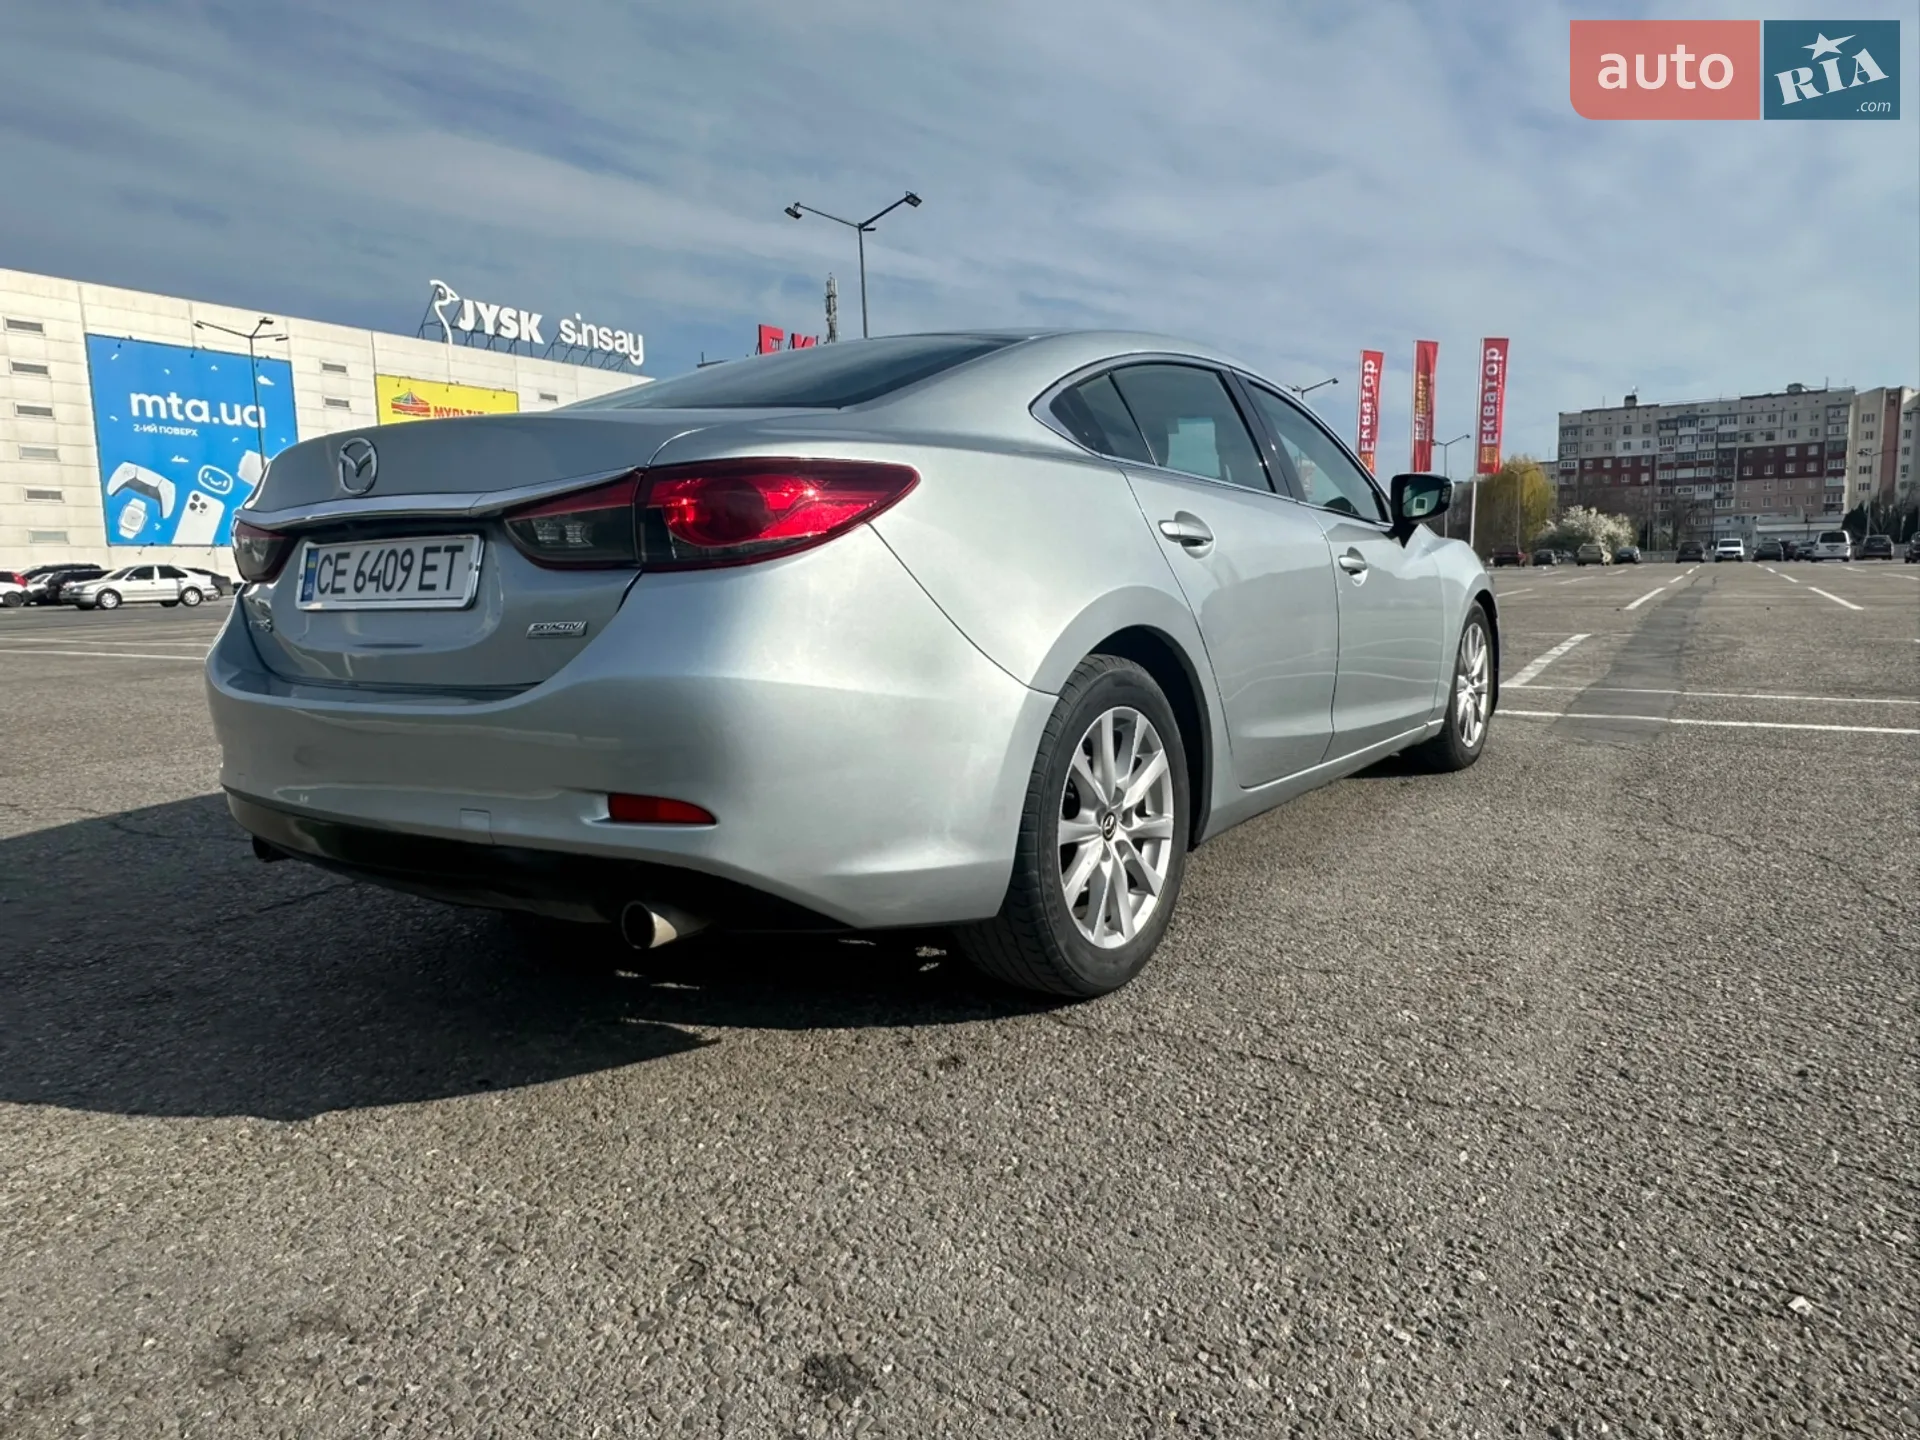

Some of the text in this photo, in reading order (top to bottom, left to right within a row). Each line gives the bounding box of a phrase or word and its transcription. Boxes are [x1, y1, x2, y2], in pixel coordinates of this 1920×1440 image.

[458, 299, 545, 345] JYSK
[559, 312, 644, 366] sinsay
[130, 391, 267, 429] mta.ua
[159, 425, 199, 437] ПОВЕРХ
[317, 545, 464, 594] CE 6409 ET
